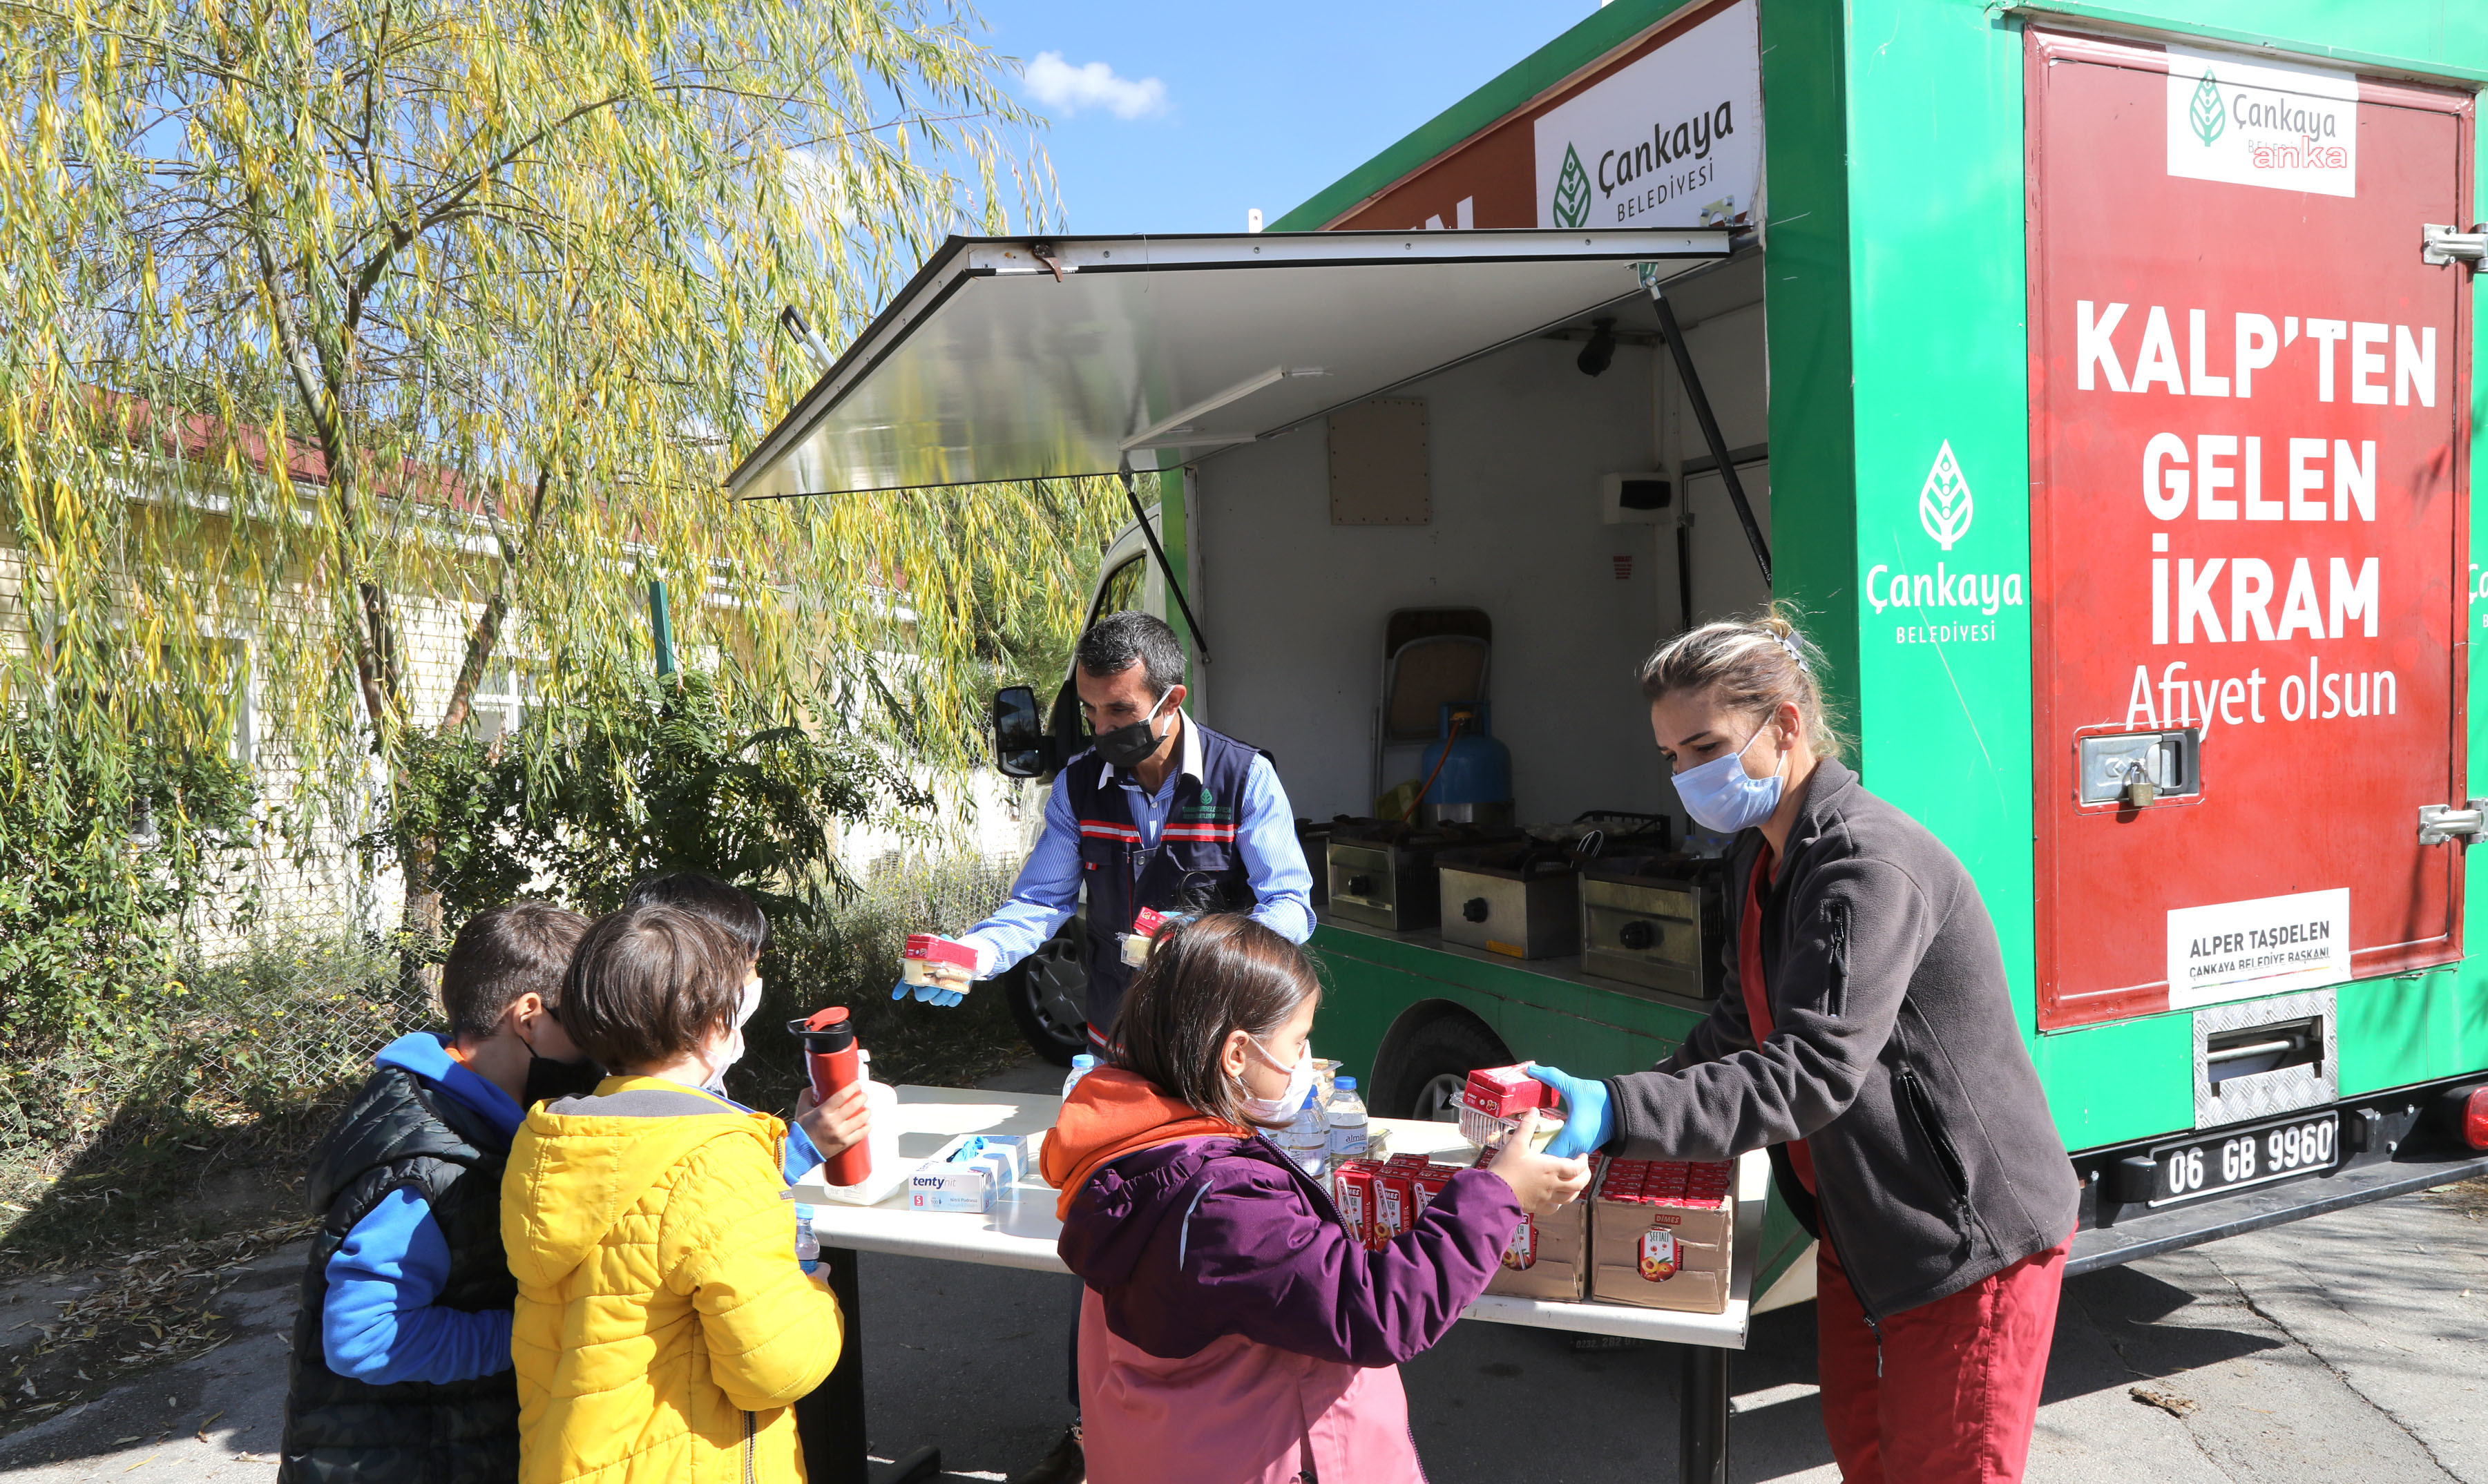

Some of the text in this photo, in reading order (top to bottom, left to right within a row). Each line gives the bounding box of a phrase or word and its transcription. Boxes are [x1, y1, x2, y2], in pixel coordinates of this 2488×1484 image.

[1598, 101, 1734, 200] Çankaya
[2232, 93, 2336, 143] Çankaya
[1618, 157, 1713, 222] BELEDİYESİ
[2076, 299, 2437, 408] KALP'TEN
[2142, 432, 2376, 522] GELEN
[1866, 561, 2023, 615] Çankaya
[2152, 532, 2380, 645] İKRAM
[1896, 619, 1996, 644] BELEDİYESİ
[2125, 655, 2396, 744] Afiyet olsun
[2190, 920, 2330, 958] ALPER TAŞDELEN
[2190, 947, 2330, 981] ÇANKAYA BELEDİYE BAŞKANI
[2169, 1119, 2333, 1194] 06 GB 9960
